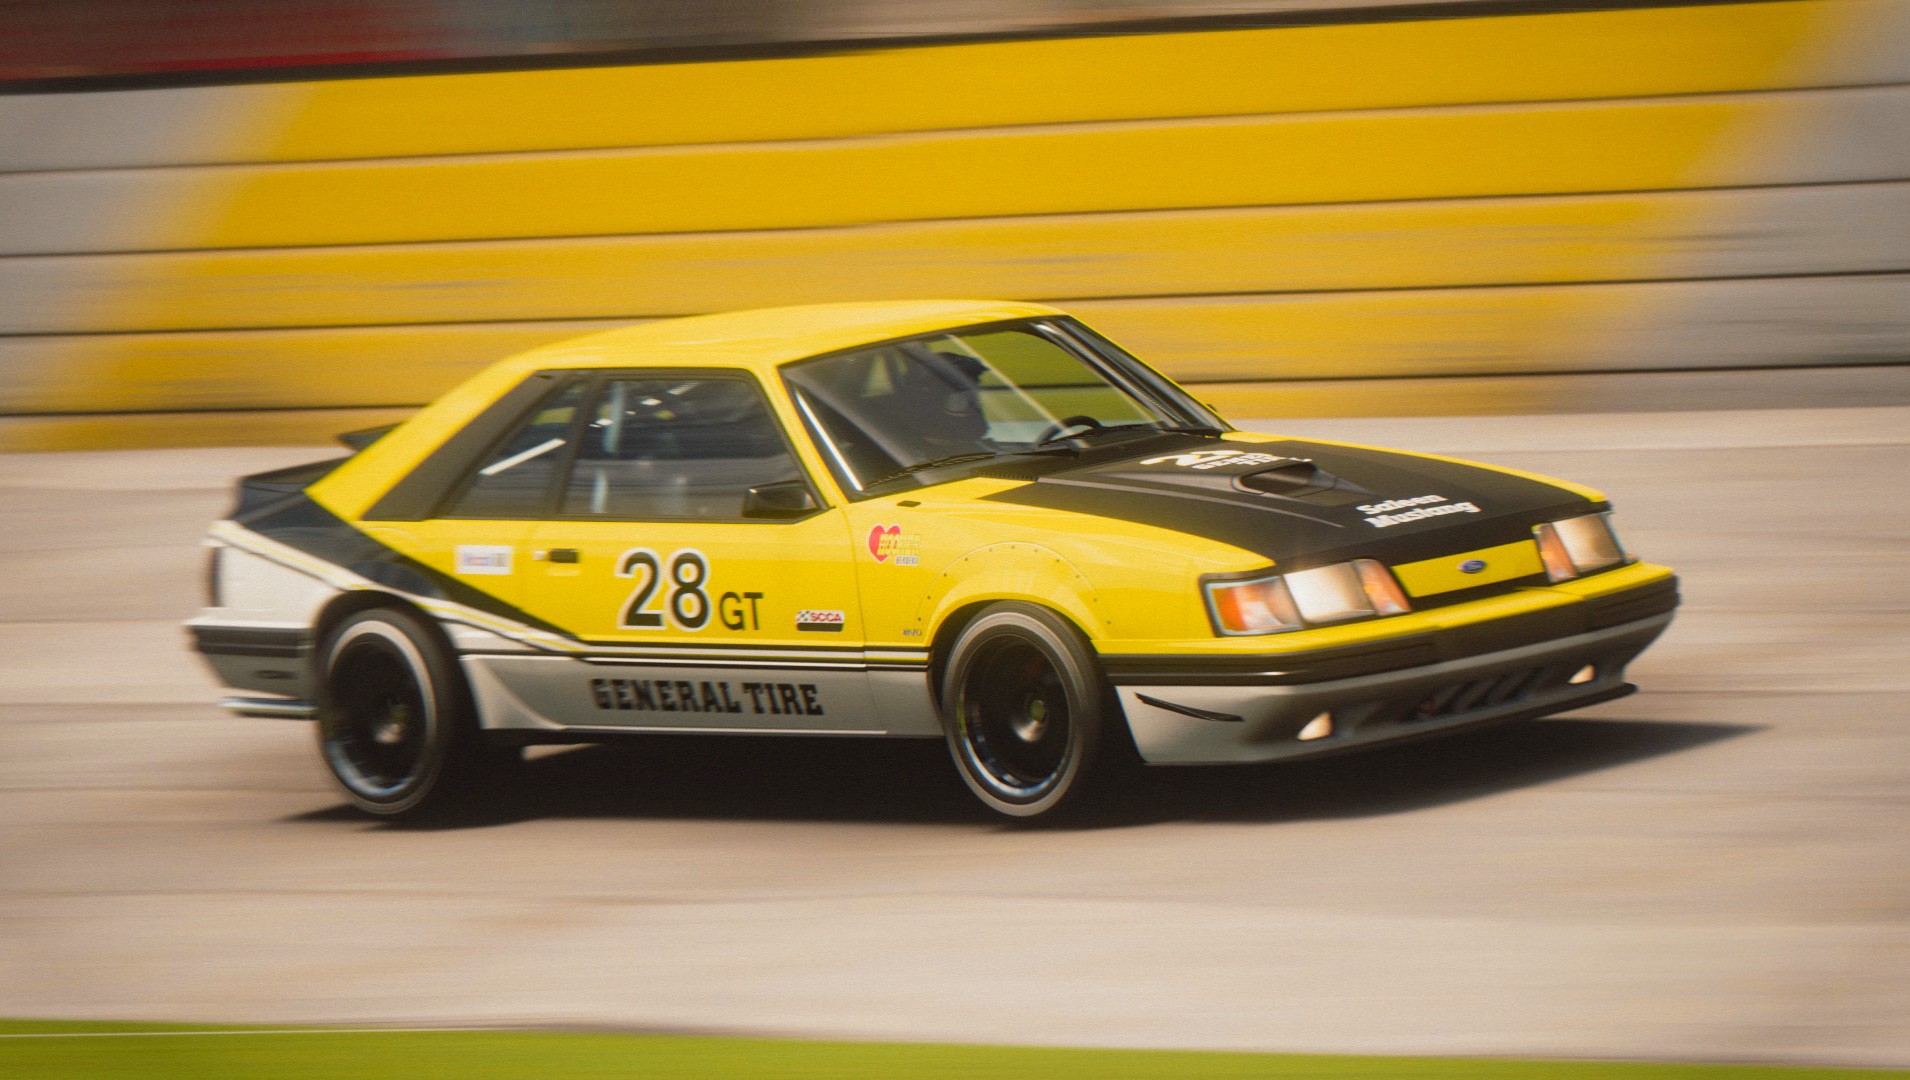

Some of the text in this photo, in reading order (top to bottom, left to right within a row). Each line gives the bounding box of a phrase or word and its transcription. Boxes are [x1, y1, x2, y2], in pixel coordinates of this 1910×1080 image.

[1356, 494, 1449, 514] Saleen
[1363, 502, 1482, 528] Mustang
[615, 547, 764, 631] 28 GT
[810, 612, 842, 622] SCCA
[590, 678, 824, 715] GENERAL TIRE
